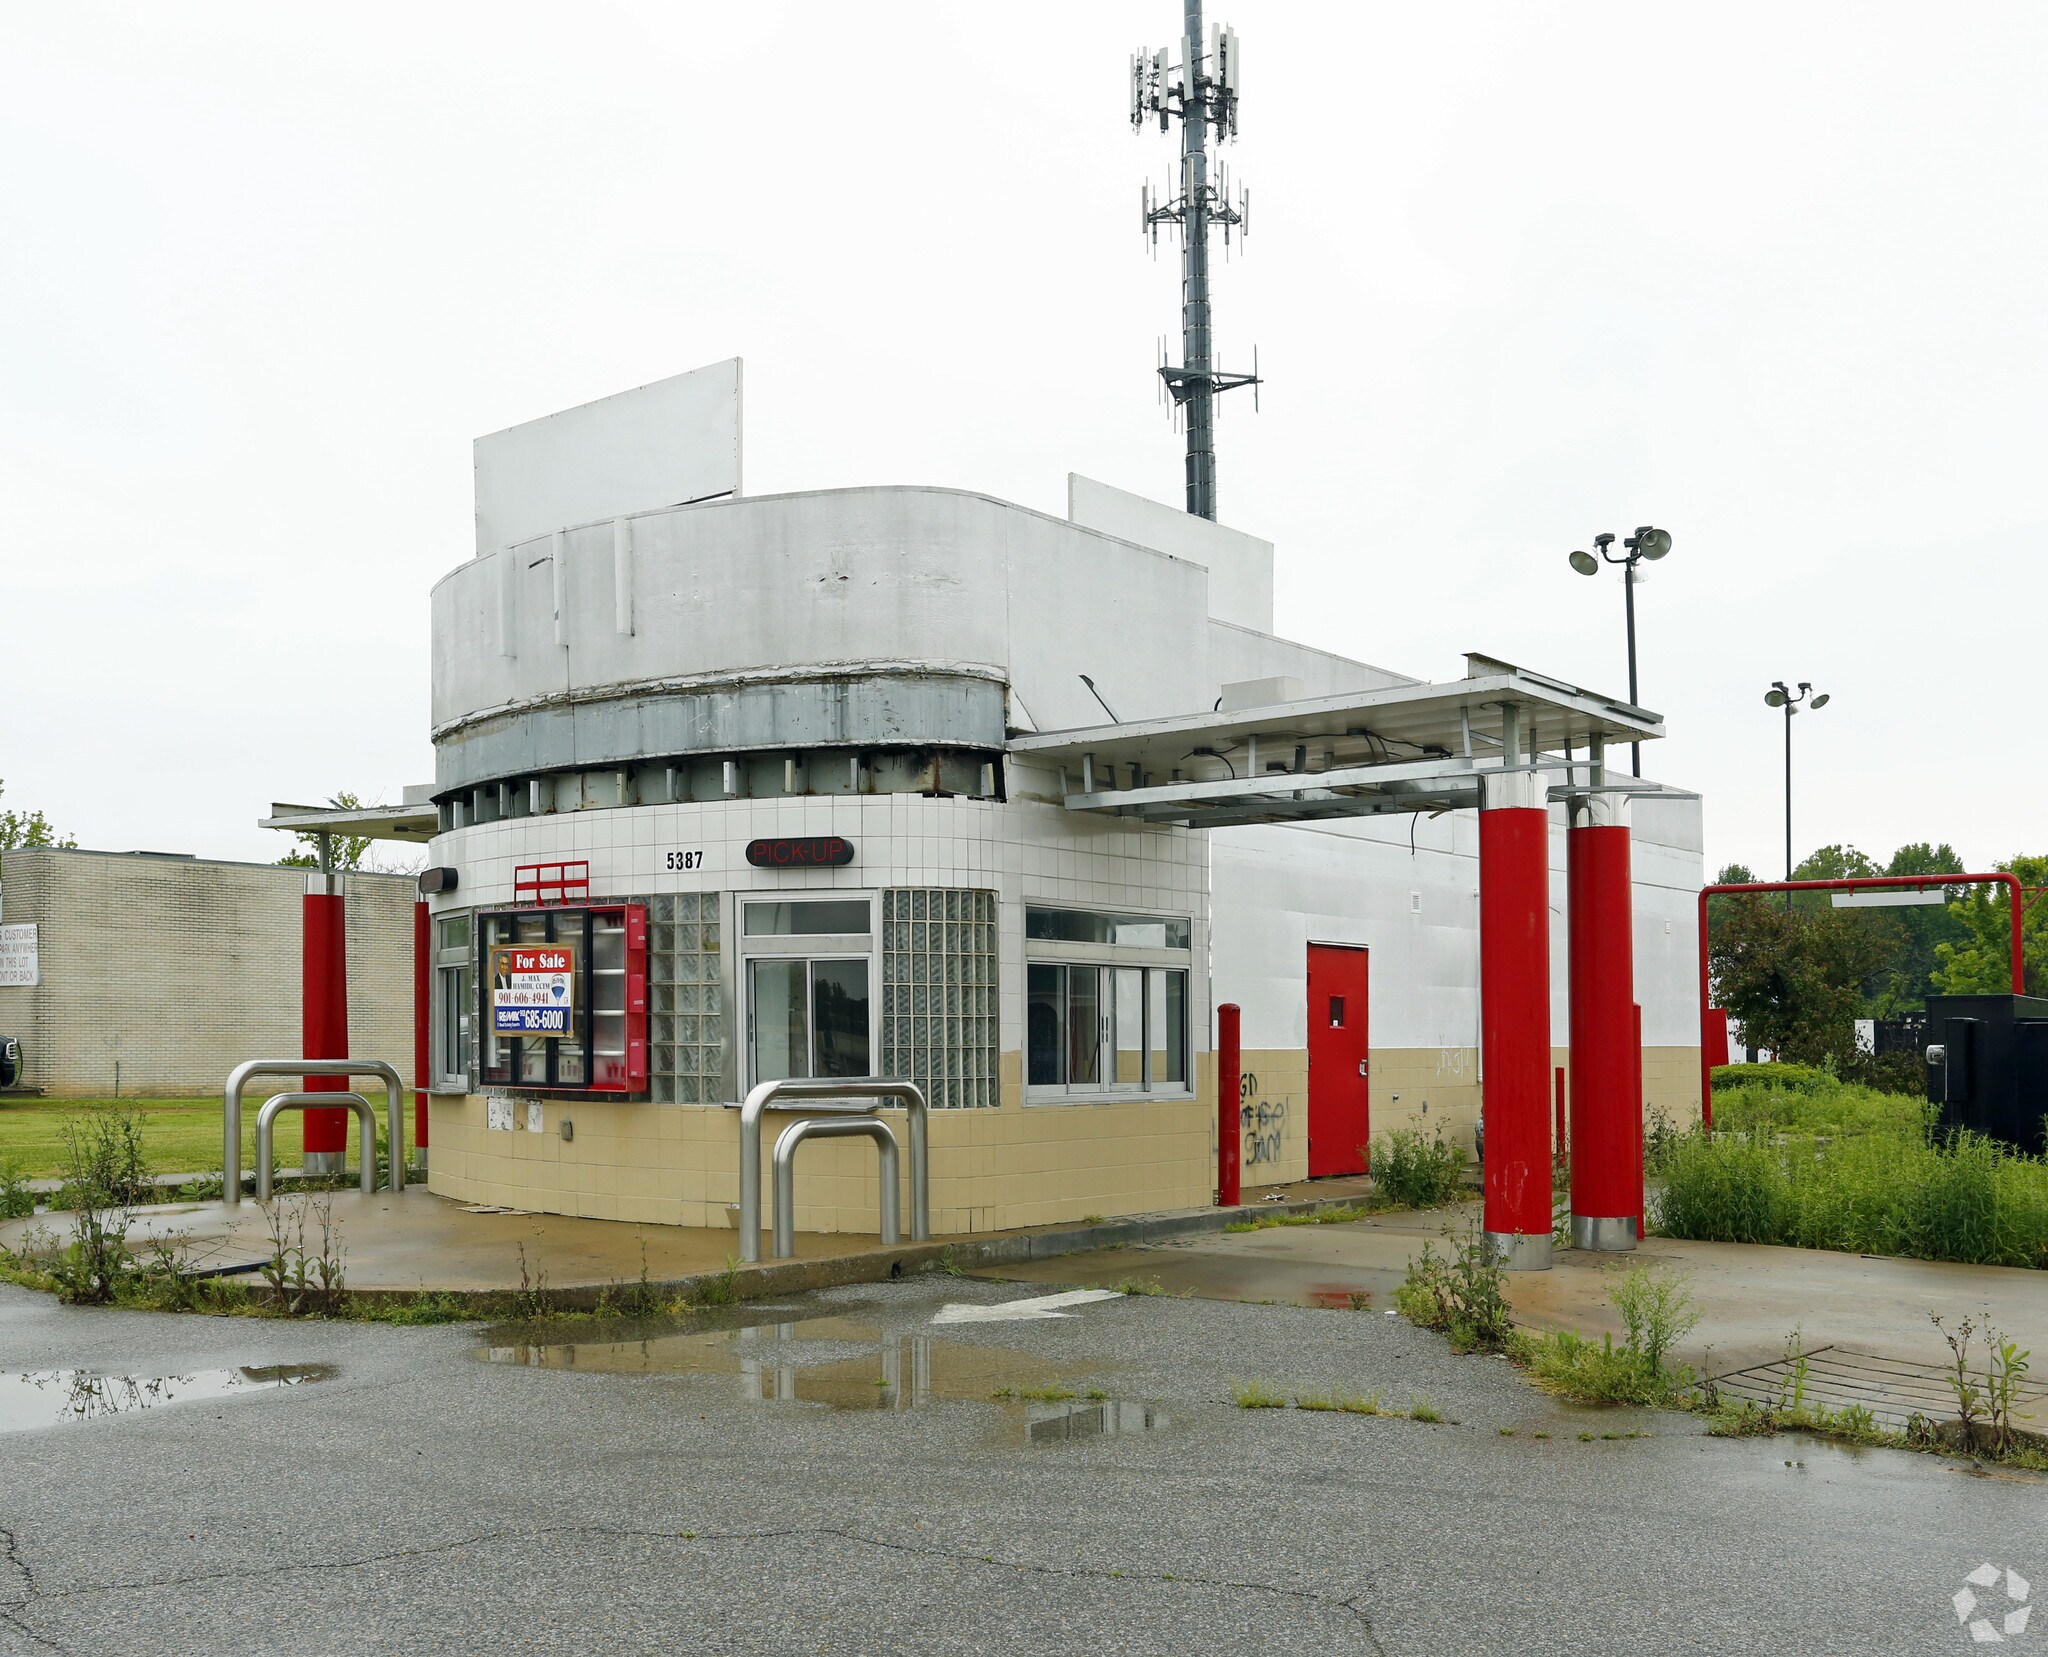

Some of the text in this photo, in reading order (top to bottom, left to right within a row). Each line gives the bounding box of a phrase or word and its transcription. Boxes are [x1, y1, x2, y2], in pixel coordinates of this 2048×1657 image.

[754, 840, 843, 863] PICK-UP
[666, 851, 703, 870] 5387
[6, 956, 17, 968] THIS
[19, 956, 29, 968] LOT
[516, 953, 565, 968] For Sale
[10, 970, 18, 982] OR
[20, 970, 33, 981] BACK
[498, 992, 549, 1004] 901-606-4941
[525, 1009, 564, 1029] 685-6000
